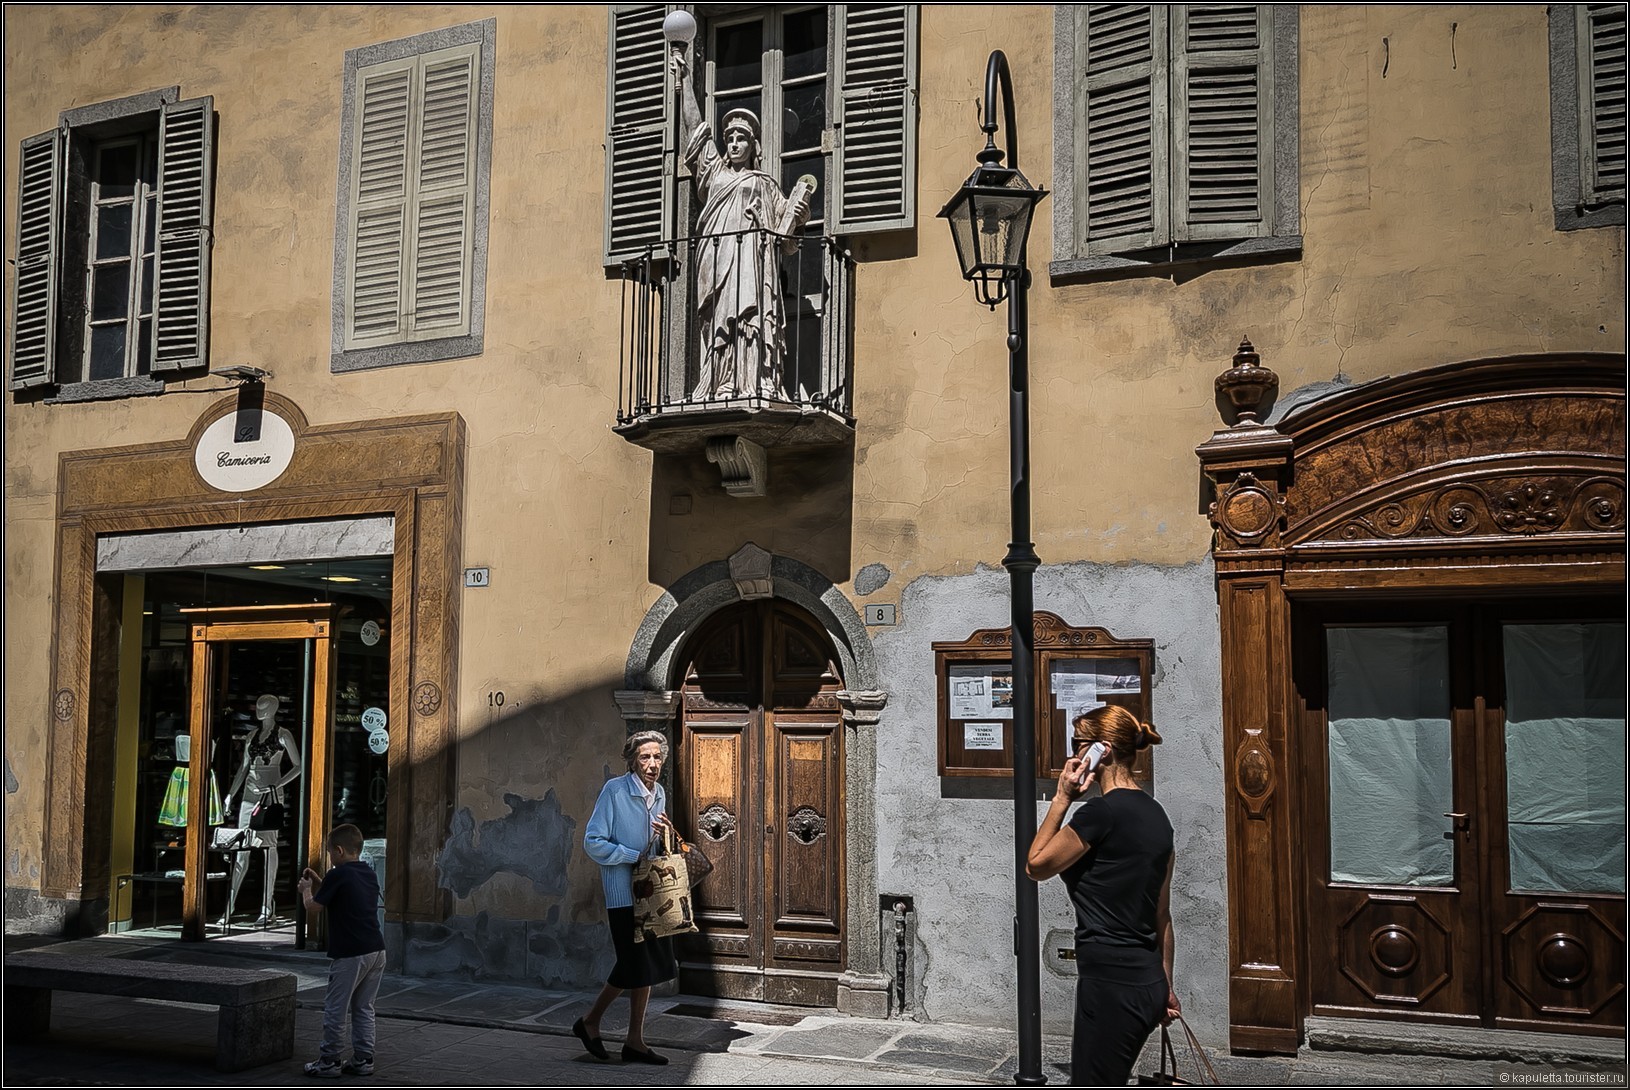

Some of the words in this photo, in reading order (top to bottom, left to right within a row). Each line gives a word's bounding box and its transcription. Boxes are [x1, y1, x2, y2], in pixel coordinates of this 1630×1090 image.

[217, 451, 271, 467] Camiceria
[472, 572, 482, 582] 10
[877, 609, 884, 620] 8
[488, 692, 504, 706] 10
[363, 715, 374, 725] 50
[370, 738, 380, 746] 50
